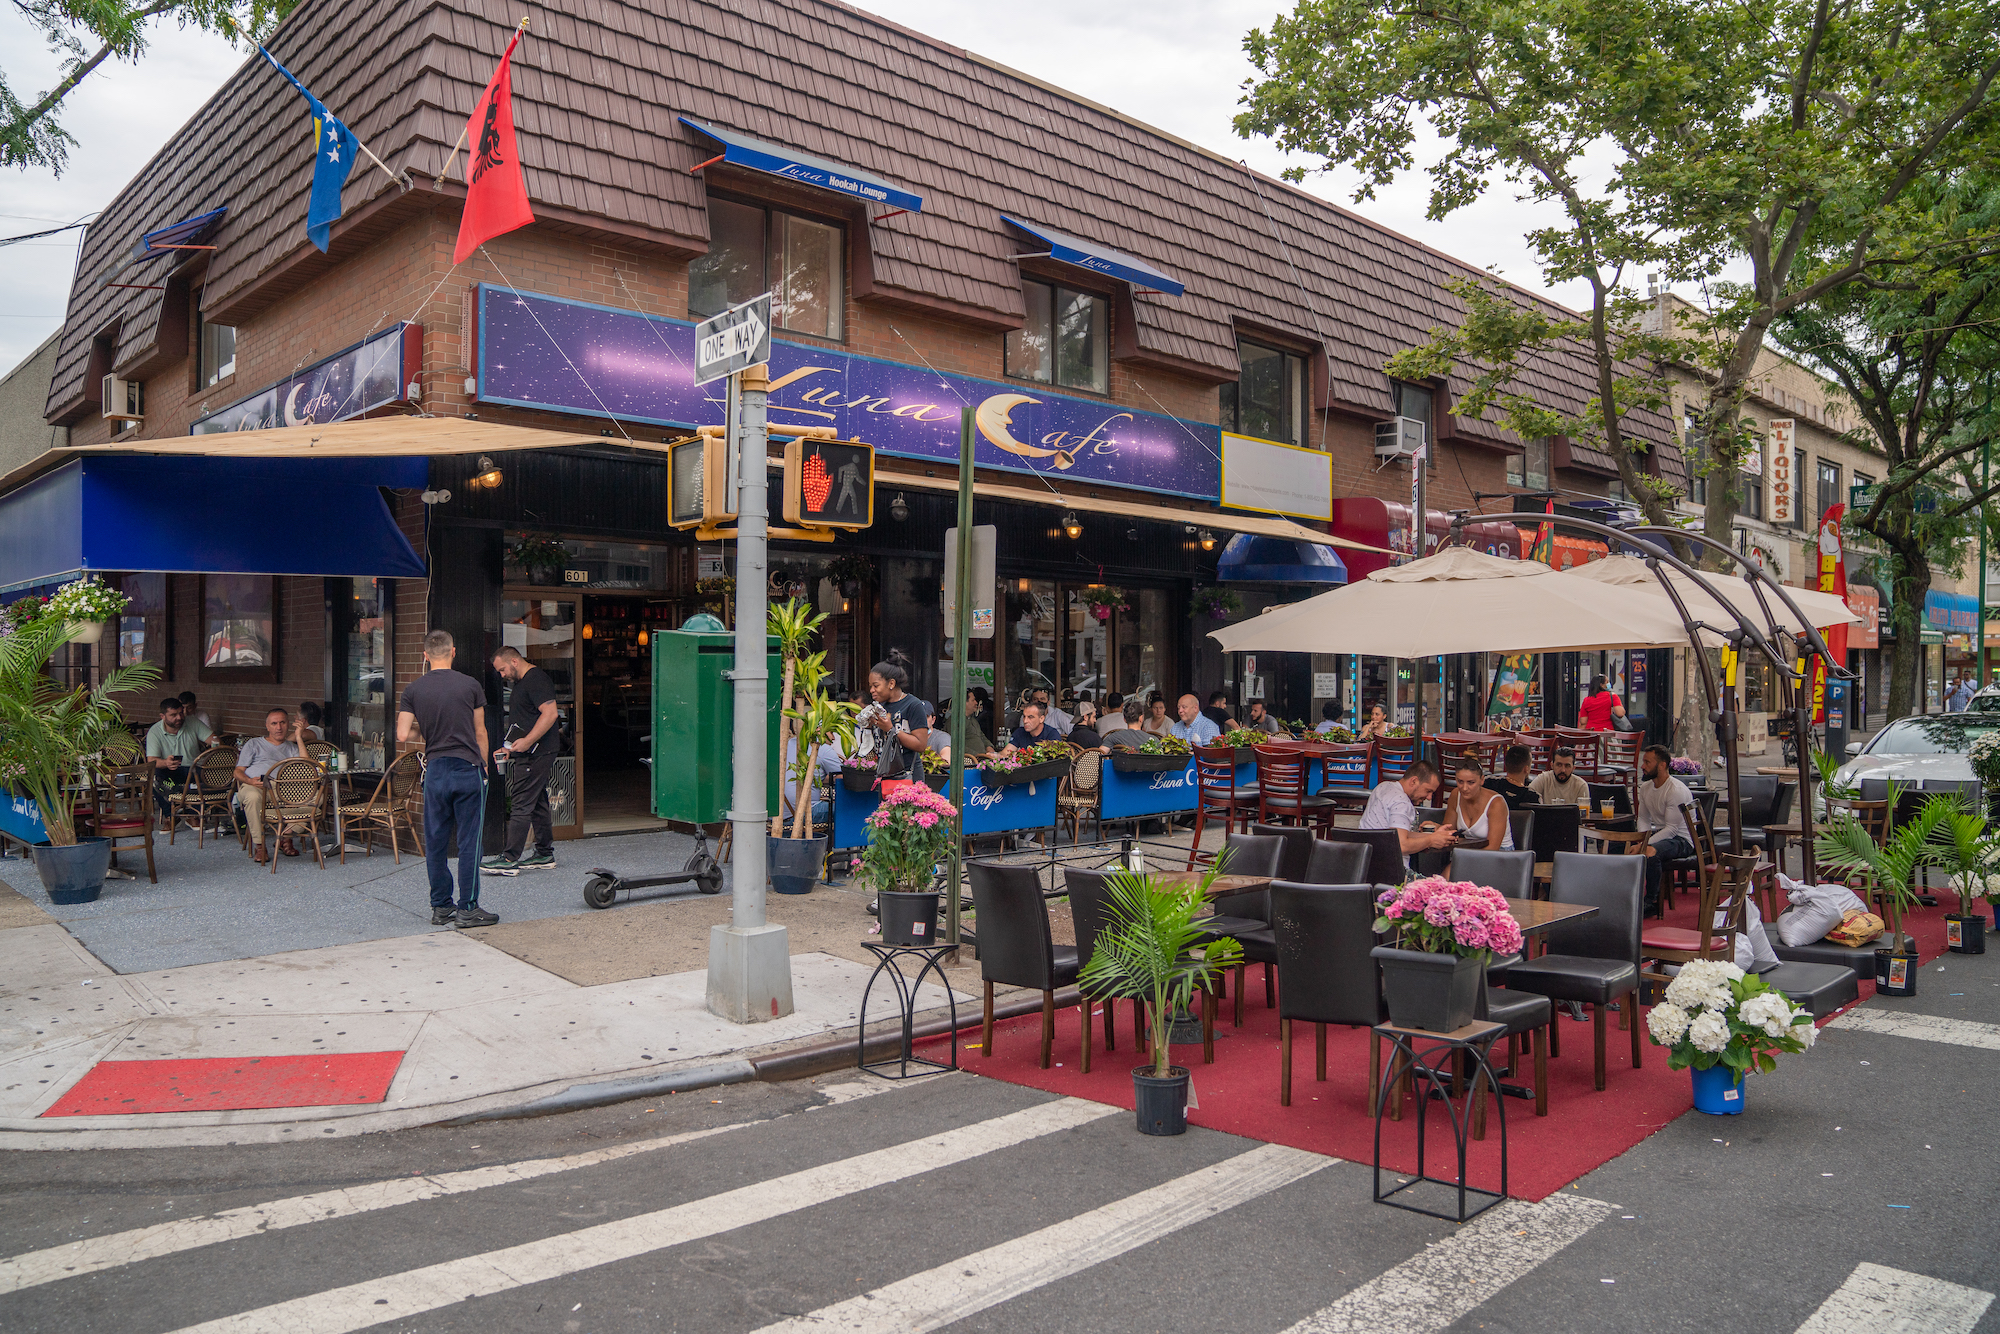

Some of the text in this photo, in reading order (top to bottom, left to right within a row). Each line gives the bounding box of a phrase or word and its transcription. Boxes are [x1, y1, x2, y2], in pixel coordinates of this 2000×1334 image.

[769, 163, 888, 201] Luna Hookah Lounge
[1075, 255, 1113, 271] Luna
[704, 321, 758, 363] ONE WAY
[703, 366, 955, 422] Luna
[238, 411, 275, 431] Lna
[1774, 430, 1790, 519] LIQUORS
[566, 571, 586, 581] 601
[1950, 609, 1979, 627] PHARMAC
[1833, 686, 1842, 698] P
[1396, 707, 1415, 723] COFFEE
[1149, 770, 1184, 790] Luna
[970, 785, 1004, 811] Cafe
